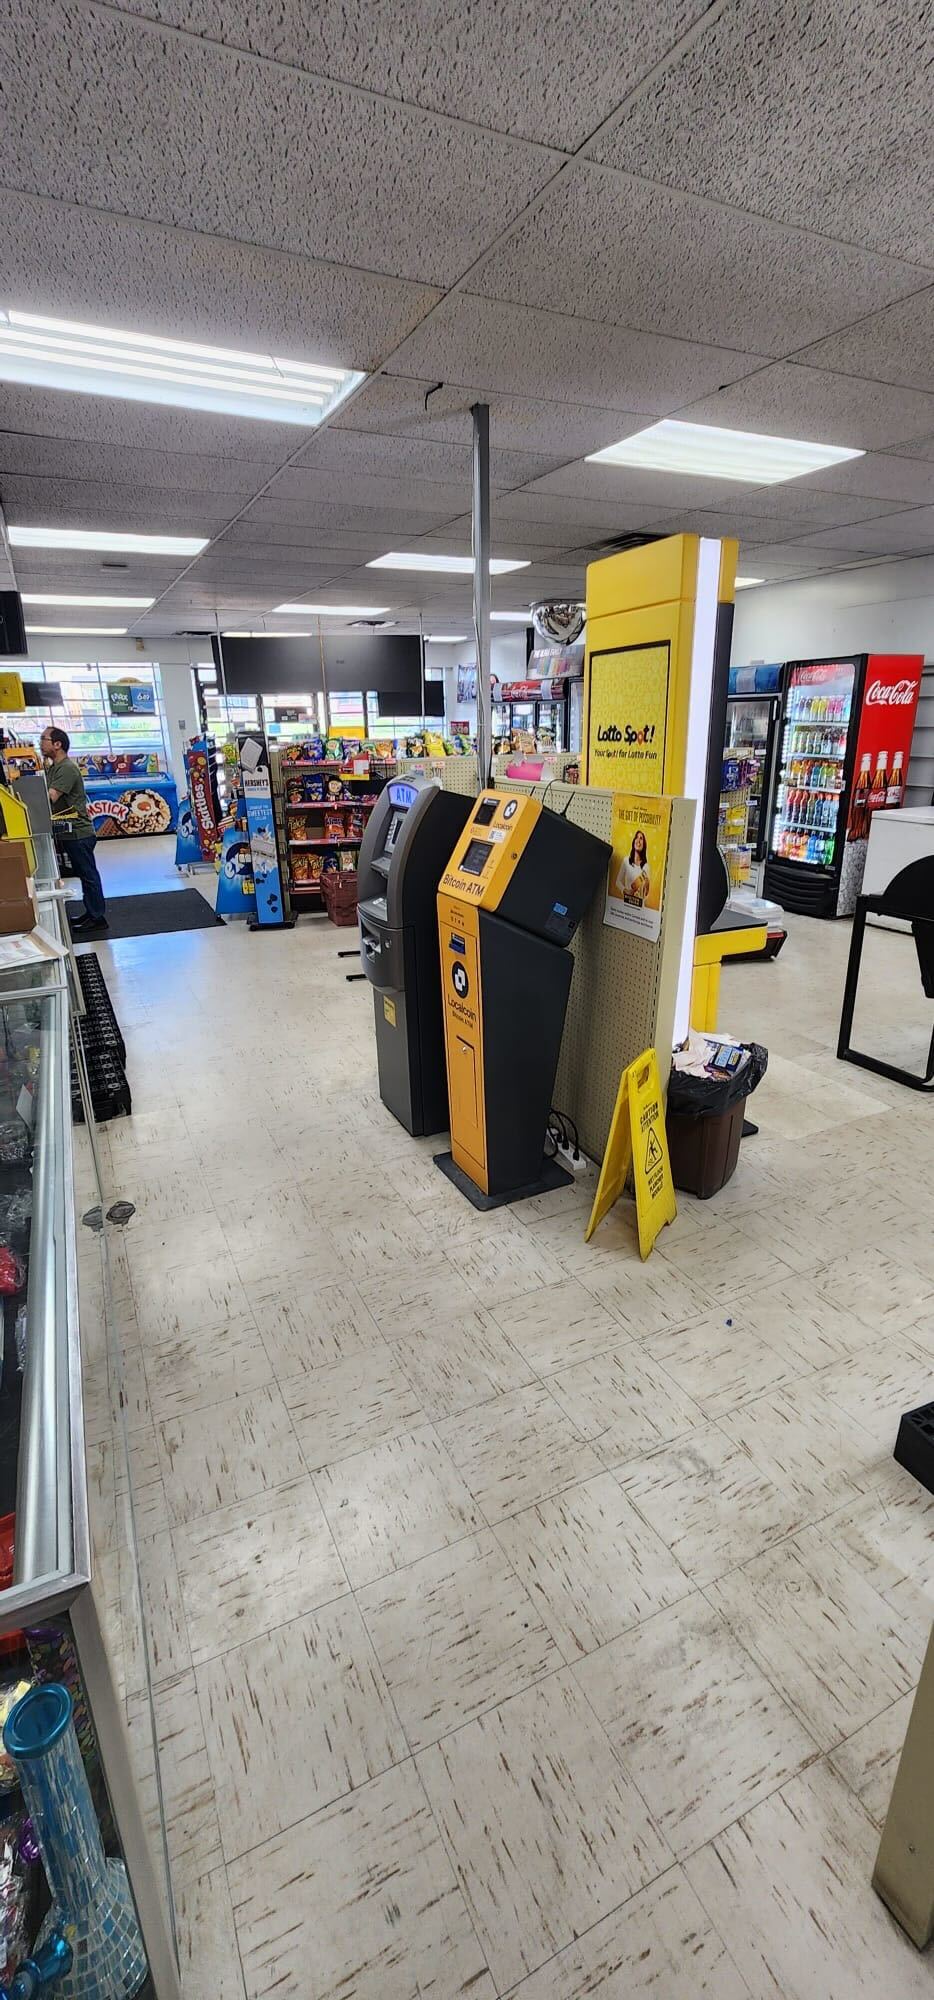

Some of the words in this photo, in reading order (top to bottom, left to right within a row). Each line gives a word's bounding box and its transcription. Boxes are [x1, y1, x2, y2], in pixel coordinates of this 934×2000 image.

[866, 679, 918, 705] Coca-Cola
[597, 725, 622, 742] Lotto
[624, 724, 655, 746] Spot!
[619, 749, 628, 759] for
[628, 750, 645, 760] Lotto
[645, 750, 658, 760] Fun
[194, 783, 215, 831] Skittles
[396, 787, 412, 804] ATM
[442, 873, 467, 891] Bitcoin
[465, 882, 486, 897] ATM
[447, 993, 477, 1023] Localcoin
[640, 1101, 658, 1125] CAUTION
